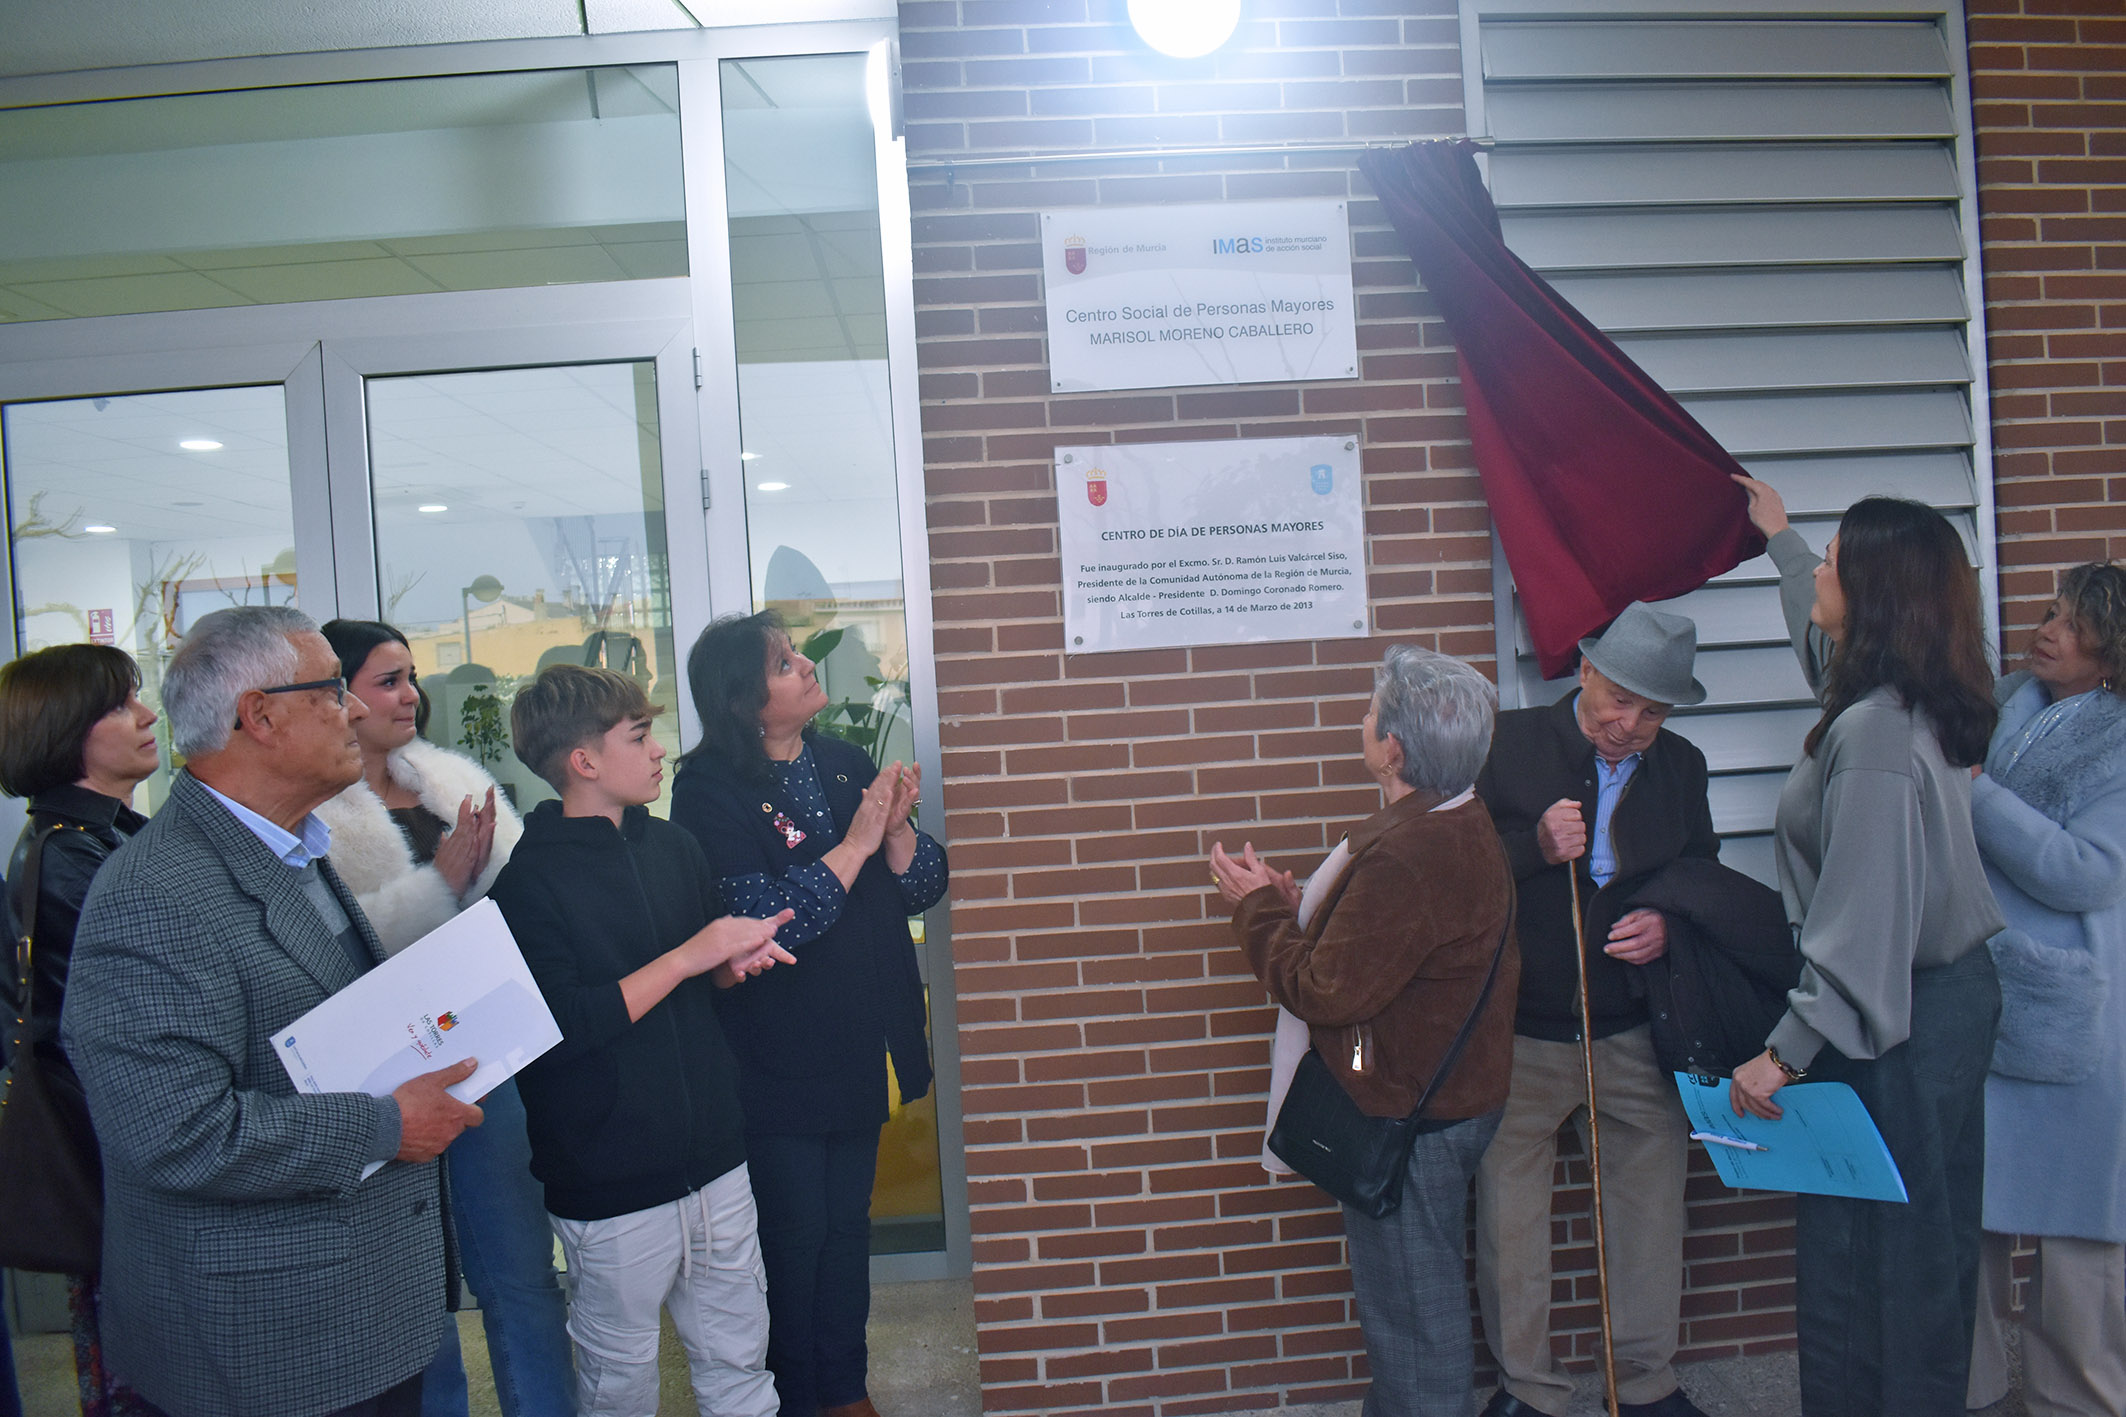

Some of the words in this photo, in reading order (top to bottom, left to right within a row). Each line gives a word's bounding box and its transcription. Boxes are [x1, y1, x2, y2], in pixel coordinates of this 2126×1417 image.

[1088, 245, 1119, 256] Región
[1122, 245, 1134, 254] de
[1136, 243, 1167, 253] Murcia
[1265, 244, 1275, 252] de
[1276, 243, 1300, 252] acción
[1301, 242, 1323, 250] social
[1295, 235, 1328, 243] murciano
[1066, 309, 1118, 323] Centro
[1122, 305, 1168, 320] Social
[1173, 304, 1192, 318] de
[1197, 303, 1267, 317] Personas
[1271, 299, 1335, 315] Mayores
[1090, 331, 1156, 345] MARISOL
[1160, 326, 1225, 342] MORENO
[1228, 322, 1314, 338] CABALLERO
[1101, 529, 1146, 541] CENTRO
[1149, 528, 1164, 539] DE
[1168, 525, 1188, 538] DÍA
[1191, 526, 1206, 537] DE
[1209, 523, 1268, 536] PERSONAS
[1271, 521, 1324, 533] MAYORES
[1080, 564, 1096, 573] Fue
[1098, 561, 1149, 573] inaugurado
[1151, 561, 1167, 571] por
[1168, 559, 1177, 568] el
[1179, 559, 1210, 568] Excmo.
[1211, 557, 1223, 566] Sr.
[1225, 557, 1234, 565] D.
[1236, 555, 1267, 565] Ramón
[1269, 554, 1286, 563] Luis
[1288, 552, 1326, 562] Valcárcel
[1328, 550, 1348, 561] Siso,
[1077, 578, 1124, 588] Presidente
[1126, 577, 1137, 586] de
[1139, 576, 1148, 585] la
[1149, 574, 1200, 585] Comunidad
[1202, 571, 1249, 581] Autónoma
[1251, 570, 1262, 579] de
[1264, 569, 1273, 578] la
[1274, 567, 1305, 579] Región
[1307, 567, 1318, 577] de
[1320, 565, 1352, 576] Murcia,
[1087, 594, 1116, 603] siendo
[1118, 592, 1151, 602] Alcalde
[1158, 590, 1205, 599] Presidente
[1210, 588, 1219, 597] D.
[1221, 586, 1261, 597] Domingo
[1263, 583, 1307, 594] Coronado
[1308, 582, 1345, 592] Romero.
[1120, 611, 1135, 619] Las
[1137, 609, 1164, 618] Torres
[1166, 608, 1178, 617] de
[1180, 606, 1215, 616] Cotillas,
[1224, 605, 1235, 613] 14
[1236, 604, 1248, 613] de
[1250, 602, 1278, 612] Marzo
[1280, 602, 1291, 610] de
[1293, 601, 1313, 610] 2013
[424, 1013, 433, 1026] LAS
[430, 1024, 444, 1047] TORRES
